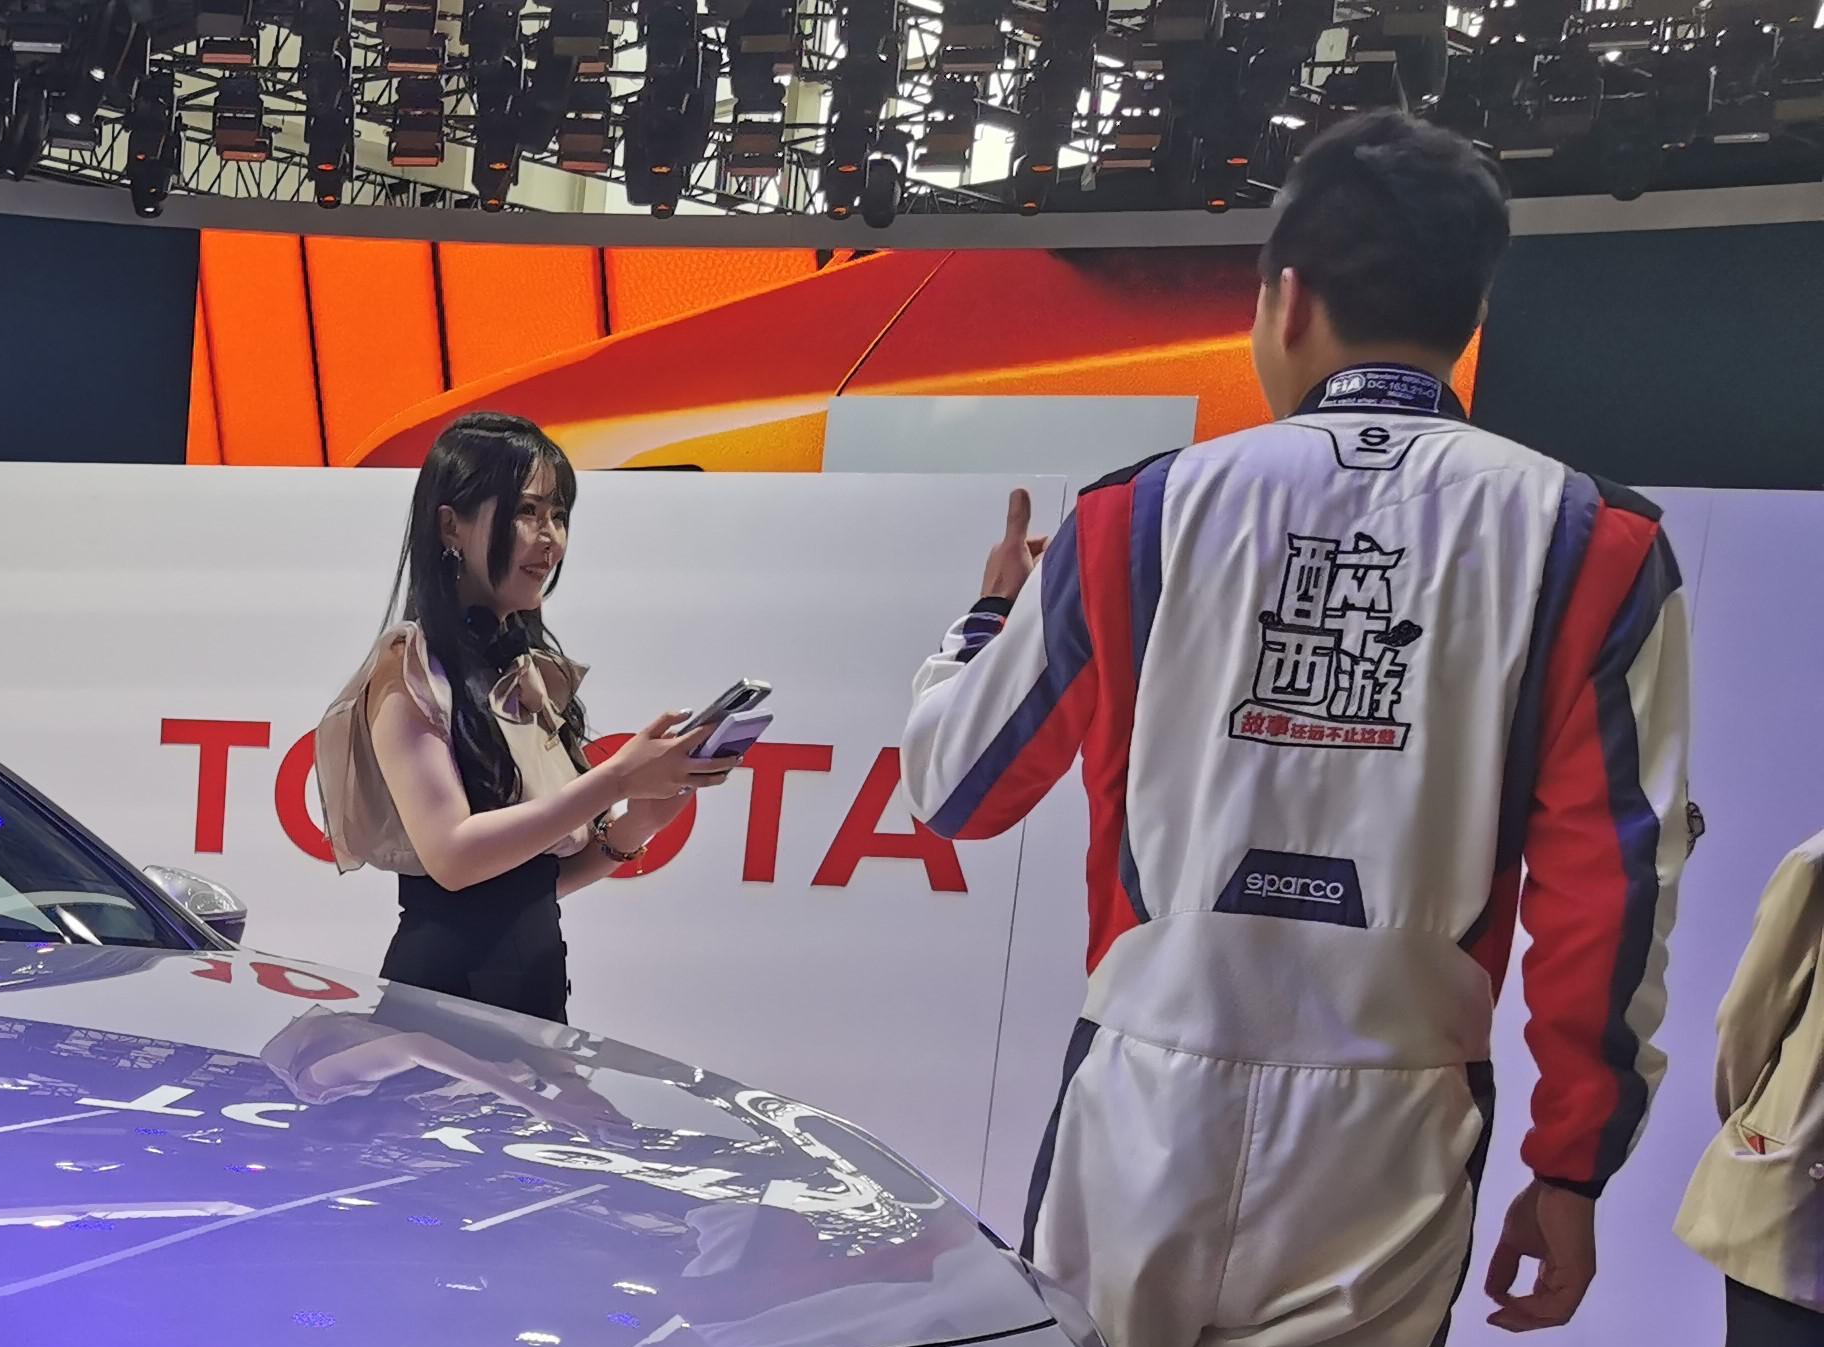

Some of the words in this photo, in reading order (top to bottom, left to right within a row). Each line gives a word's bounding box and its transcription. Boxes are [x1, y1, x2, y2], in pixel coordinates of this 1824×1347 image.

[1329, 375, 1361, 396] FIA
[160, 717, 968, 892] TOTA
[1244, 872, 1345, 900] sparco
